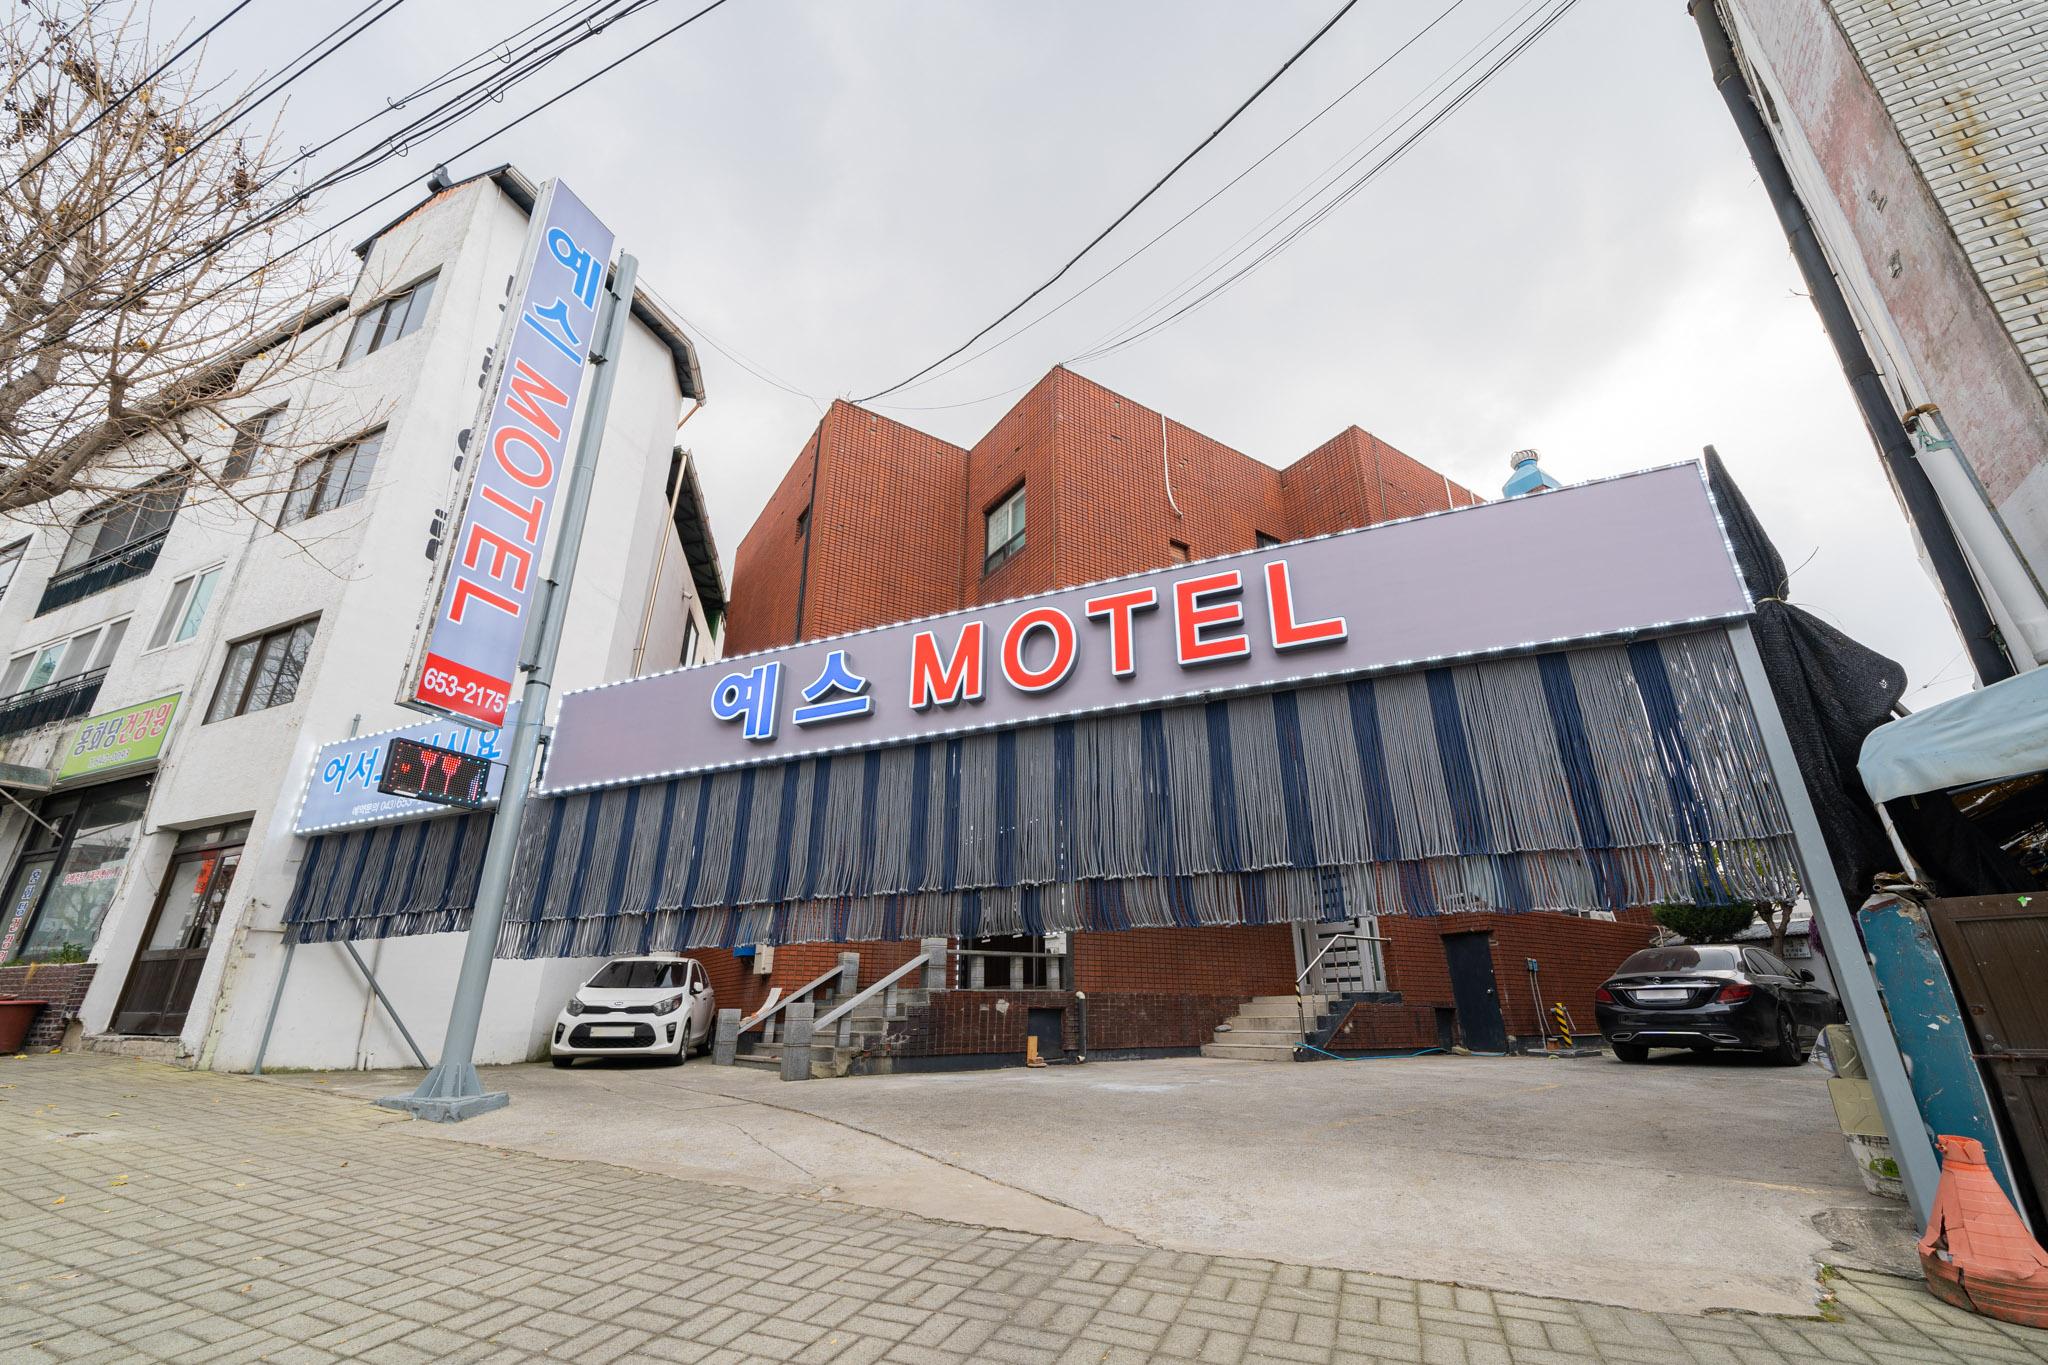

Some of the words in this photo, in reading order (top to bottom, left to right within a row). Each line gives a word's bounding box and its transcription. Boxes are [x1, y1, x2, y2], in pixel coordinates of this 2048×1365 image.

[522, 226, 602, 367] 예스
[448, 356, 570, 625] MOTEL
[424, 667, 505, 713] 653-2175
[710, 650, 875, 742] 예스
[909, 560, 1348, 711] MOTEL
[73, 703, 173, 756] 홍화당건강원
